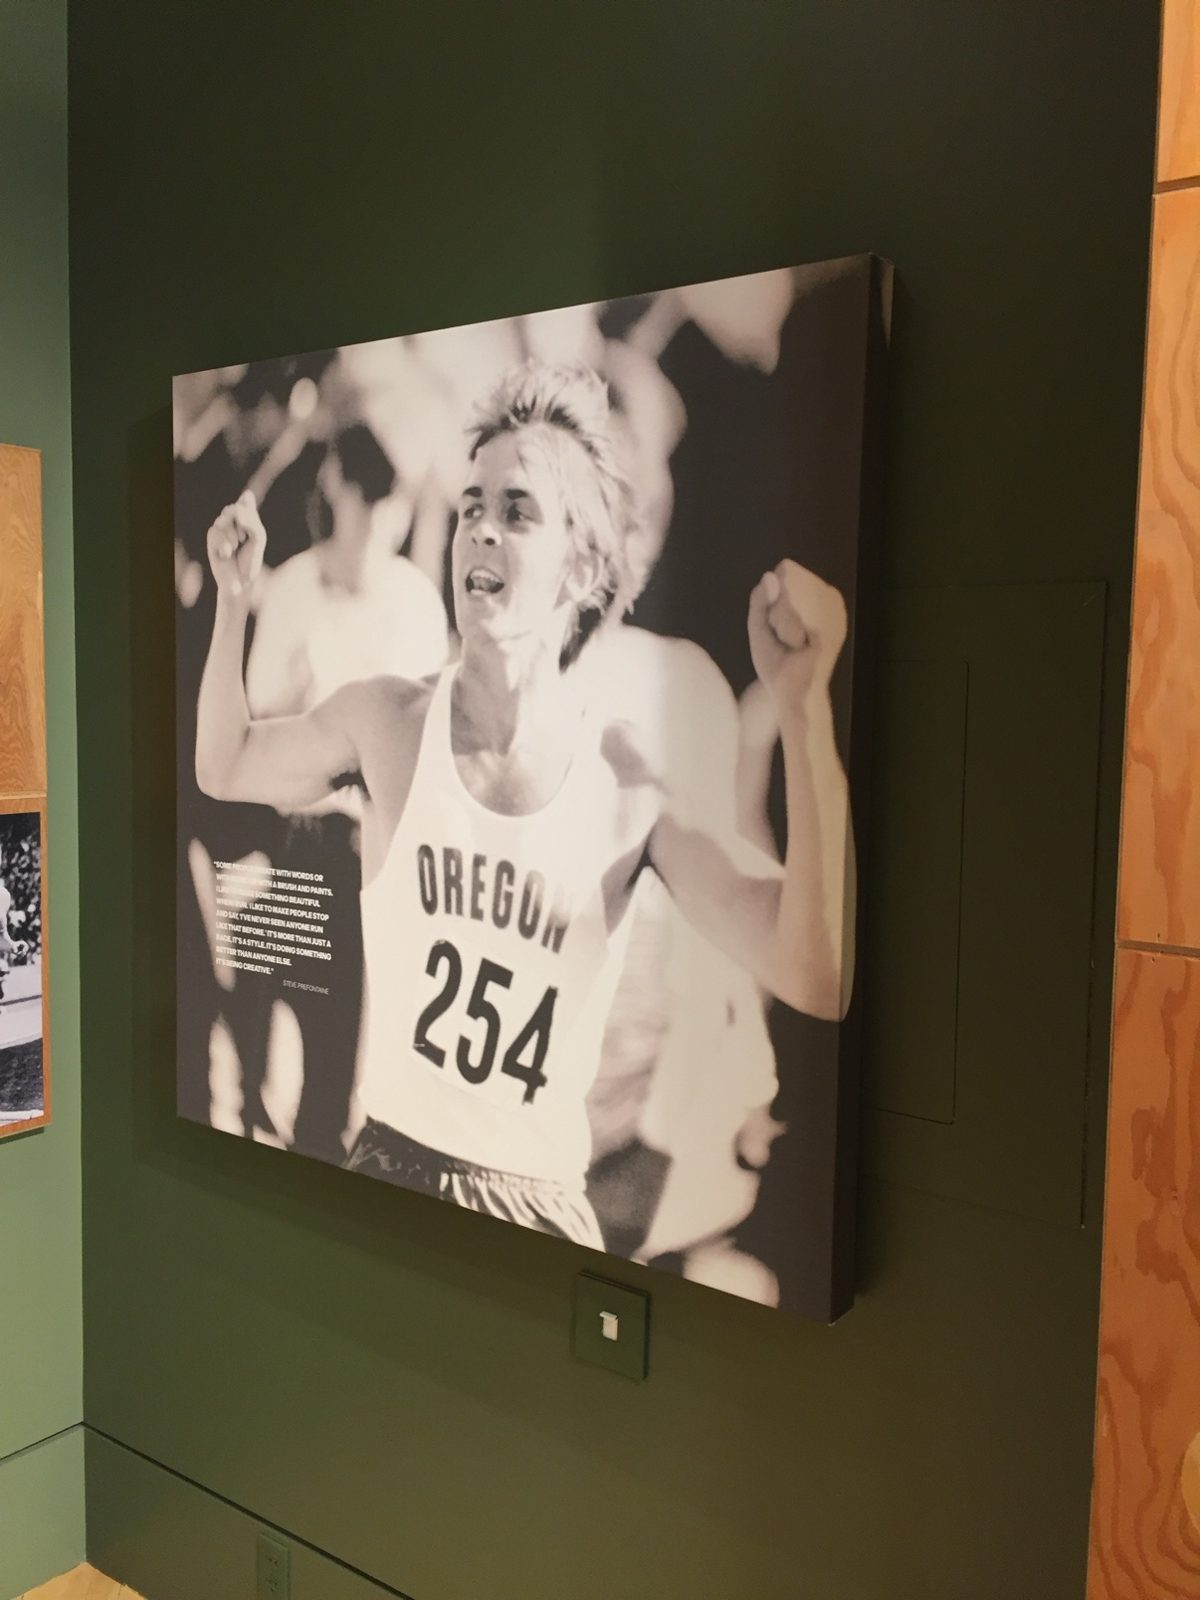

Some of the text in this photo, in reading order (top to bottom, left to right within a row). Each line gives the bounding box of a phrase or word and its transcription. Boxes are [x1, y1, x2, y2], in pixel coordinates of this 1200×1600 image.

[276, 869, 292, 877] WITH
[292, 870, 314, 880] WORDS
[278, 881, 297, 891] BRUSH
[297, 884, 310, 893] AND
[310, 886, 333, 896] PAINTS.
[289, 896, 321, 907] BEAUTIFUL
[417, 844, 570, 954] OREGON
[273, 906, 289, 915] MAKE
[290, 908, 312, 918] PEOPLE
[313, 912, 329, 921] STOP
[252, 914, 270, 924] NEVER
[271, 917, 286, 926] SEEN
[286, 920, 310, 931] ANYONE
[310, 924, 324, 933] RUN
[228, 924, 242, 932] THAT
[267, 930, 277, 938] IT'S
[278, 932, 295, 942] MORE
[296, 935, 311, 944] THAN
[312, 938, 326, 946] JUST
[236, 950, 253, 958] THAN
[253, 952, 276, 963] ANYONE
[276, 956, 292, 966] ELSE.
[266, 943, 276, 951] IT'S
[277, 944, 296, 954] DOING
[296, 947, 332, 961] SOMETHING
[412, 939, 559, 1106] 254
